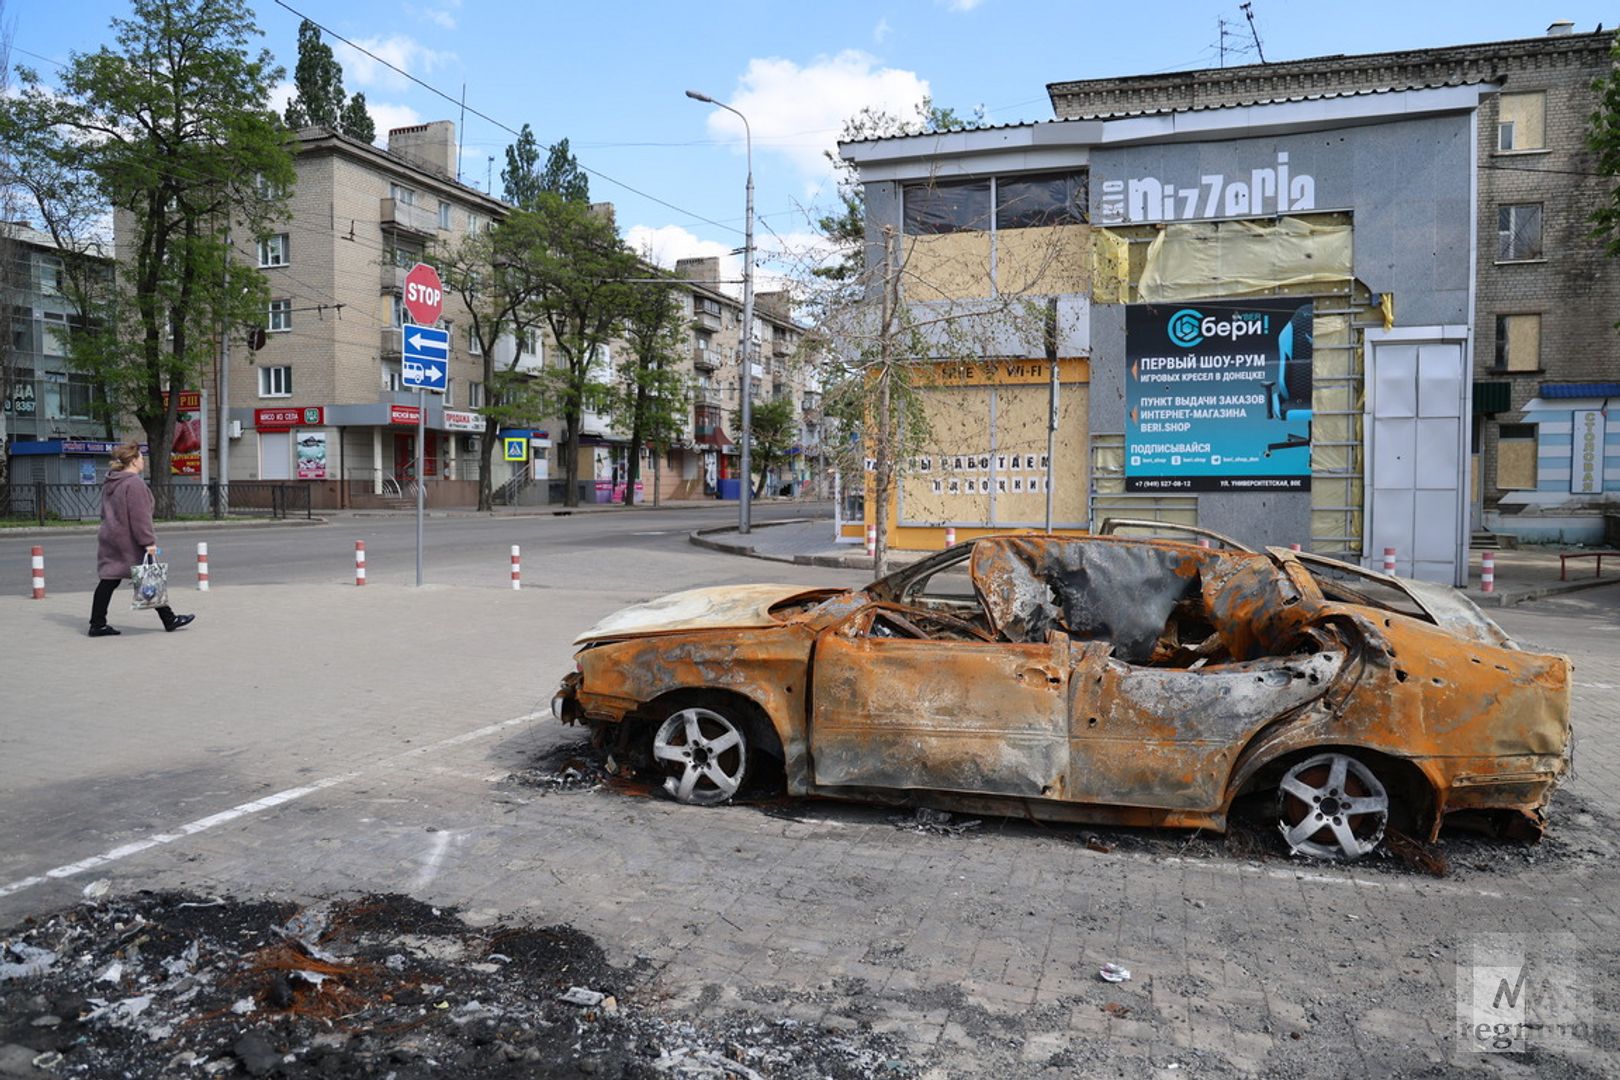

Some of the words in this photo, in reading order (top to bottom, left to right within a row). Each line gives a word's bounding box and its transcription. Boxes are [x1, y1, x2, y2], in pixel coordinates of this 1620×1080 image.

[408, 282, 441, 307] STOP
[1141, 353, 1196, 370] ПЕРВЫЙ
[1199, 354, 1266, 369] ШОУ-РУМ
[1140, 374, 1180, 383] ИГРОВЫХ
[1181, 372, 1214, 382] КРЕСЕЛ
[1215, 373, 1220, 381] В
[1222, 371, 1266, 381] ДОНЕЦКЕ!
[1140, 397, 1173, 407] ПУНКТ
[1175, 396, 1217, 407] ВЫДАЧИ
[1219, 395, 1266, 406] ЗАКАЗОВ
[1140, 408, 1247, 420] ИНТЕРНЕТ-МАГАЗИНА
[1140, 422, 1191, 433] BERI.SHOP
[1130, 442, 1211, 454] ПОДПИСЫВАЙСЯ
